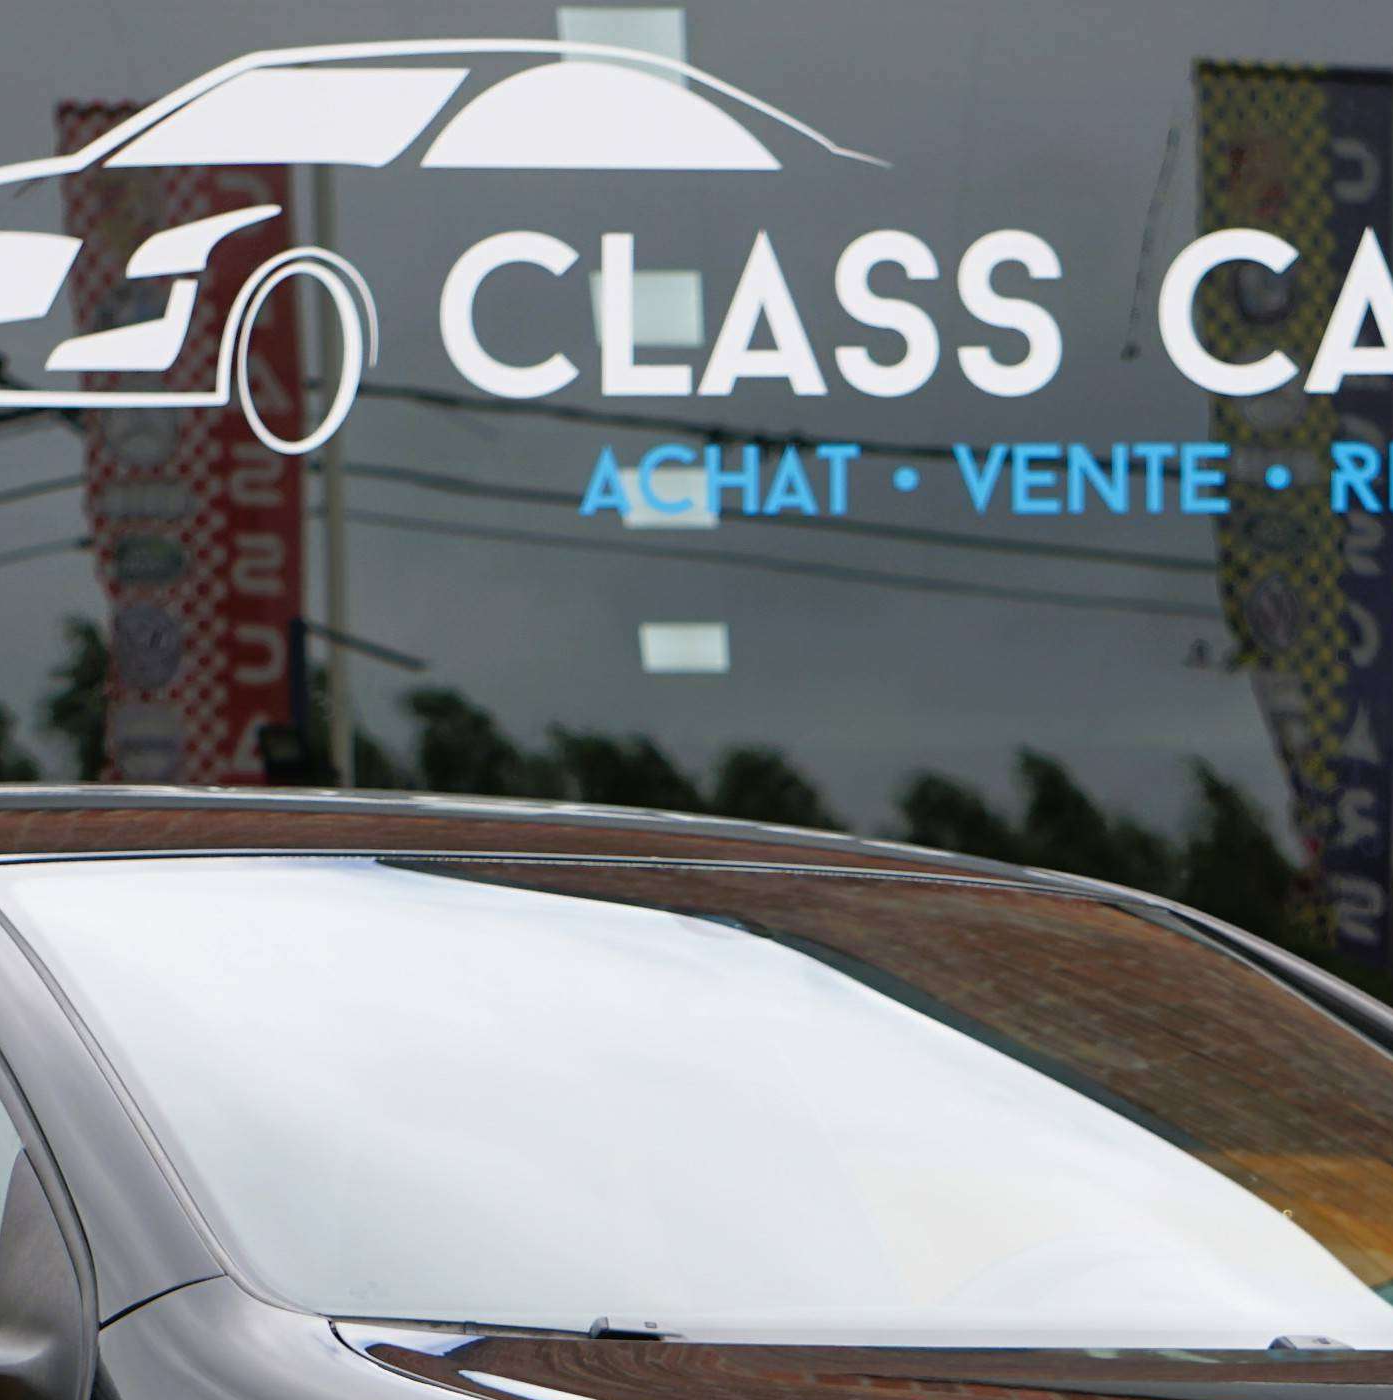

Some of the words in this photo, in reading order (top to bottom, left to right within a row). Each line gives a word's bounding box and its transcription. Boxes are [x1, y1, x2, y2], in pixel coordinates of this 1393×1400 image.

[440, 230, 1062, 398] CLASS
[579, 444, 861, 517] ACHAT
[953, 443, 1230, 514] VENTE
